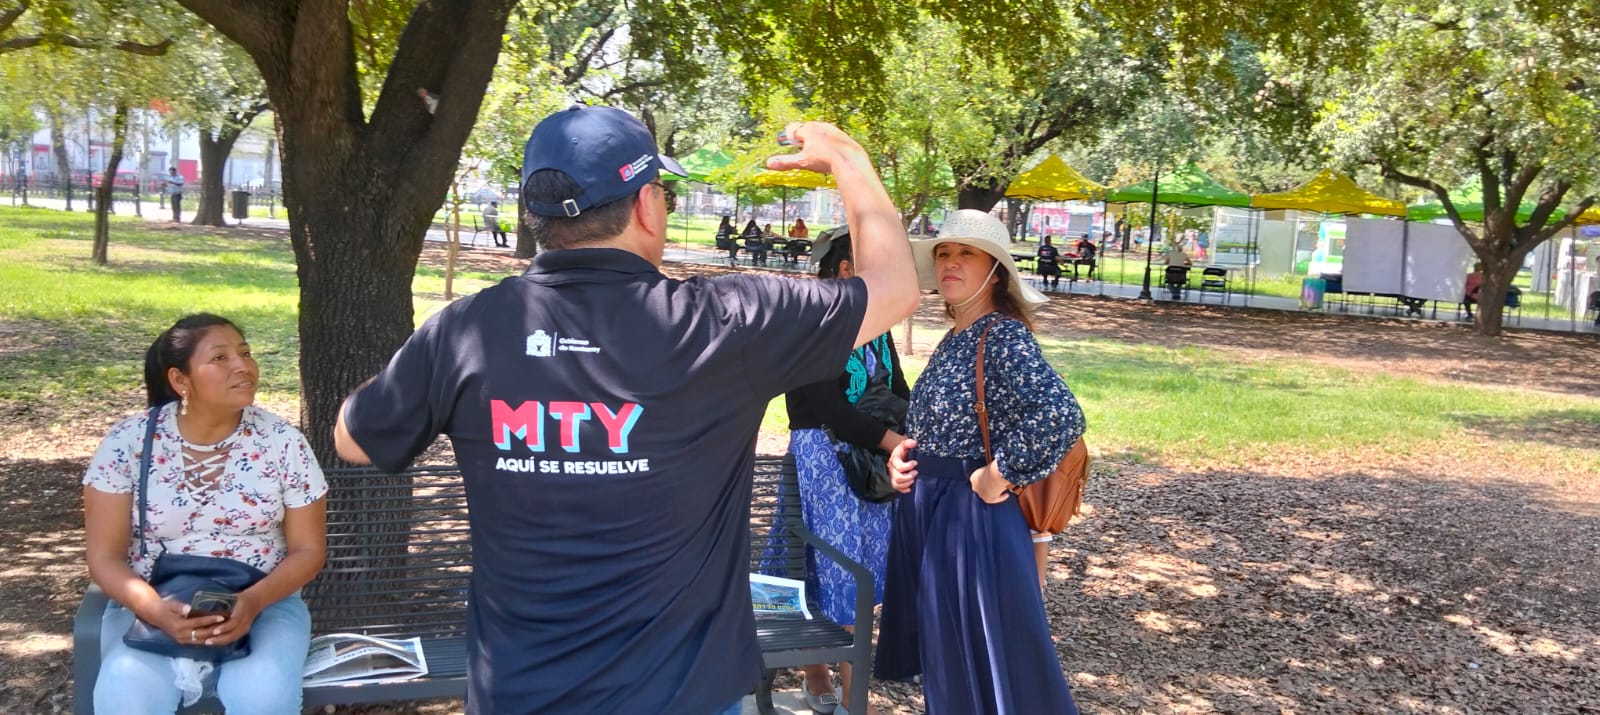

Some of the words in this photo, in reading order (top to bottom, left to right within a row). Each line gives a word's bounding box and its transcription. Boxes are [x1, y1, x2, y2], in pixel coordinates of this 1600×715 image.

[490, 399, 644, 454] MTY
[496, 456, 535, 472] AQUÍ
[539, 460, 560, 473] SE
[563, 458, 650, 475] RESUELVE
